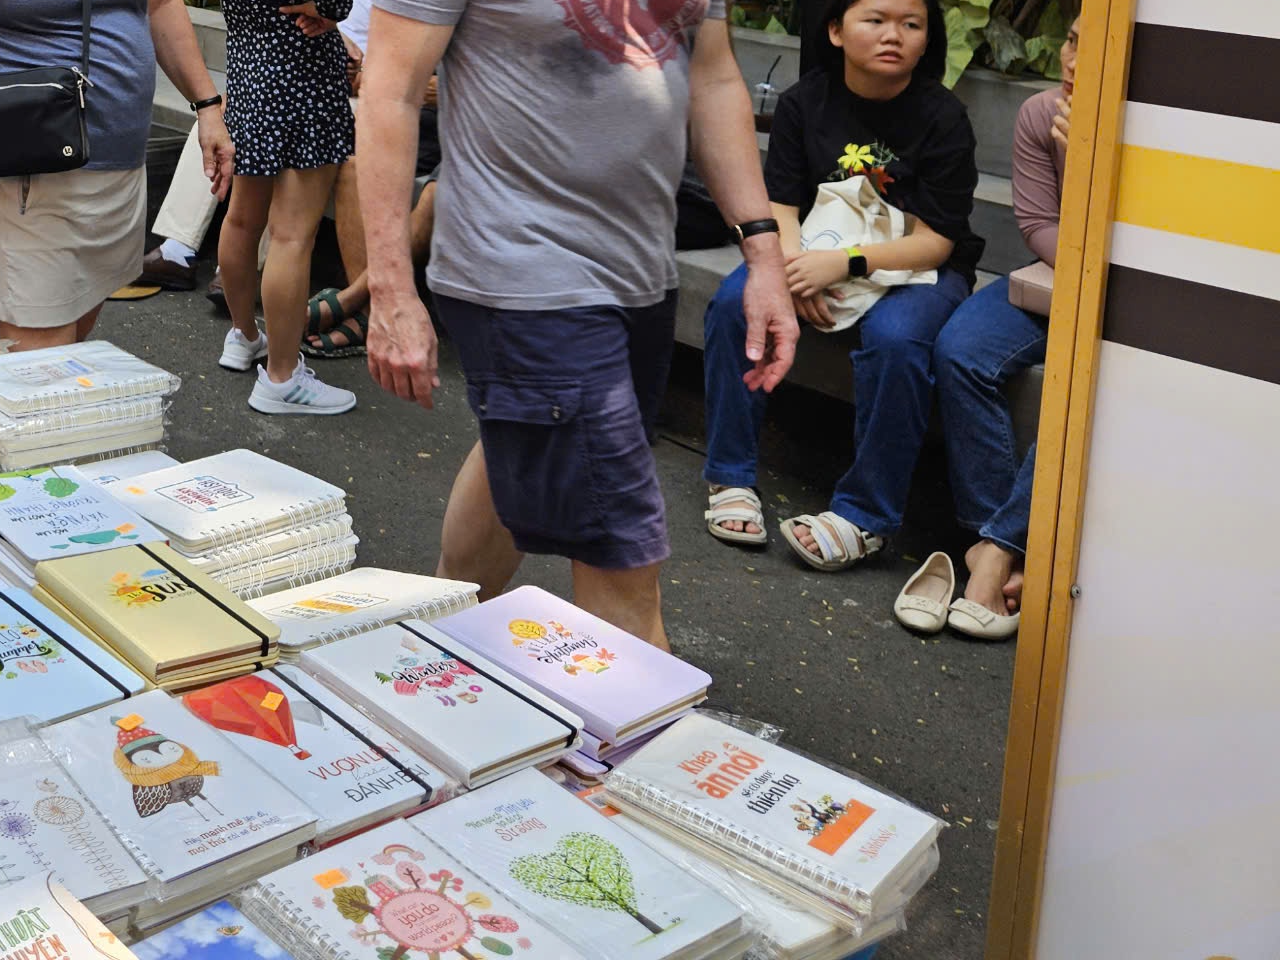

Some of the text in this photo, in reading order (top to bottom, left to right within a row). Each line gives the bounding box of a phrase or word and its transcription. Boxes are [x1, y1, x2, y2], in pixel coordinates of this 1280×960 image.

[391, 661, 459, 684] Winter
[398, 901, 440, 929] you do
